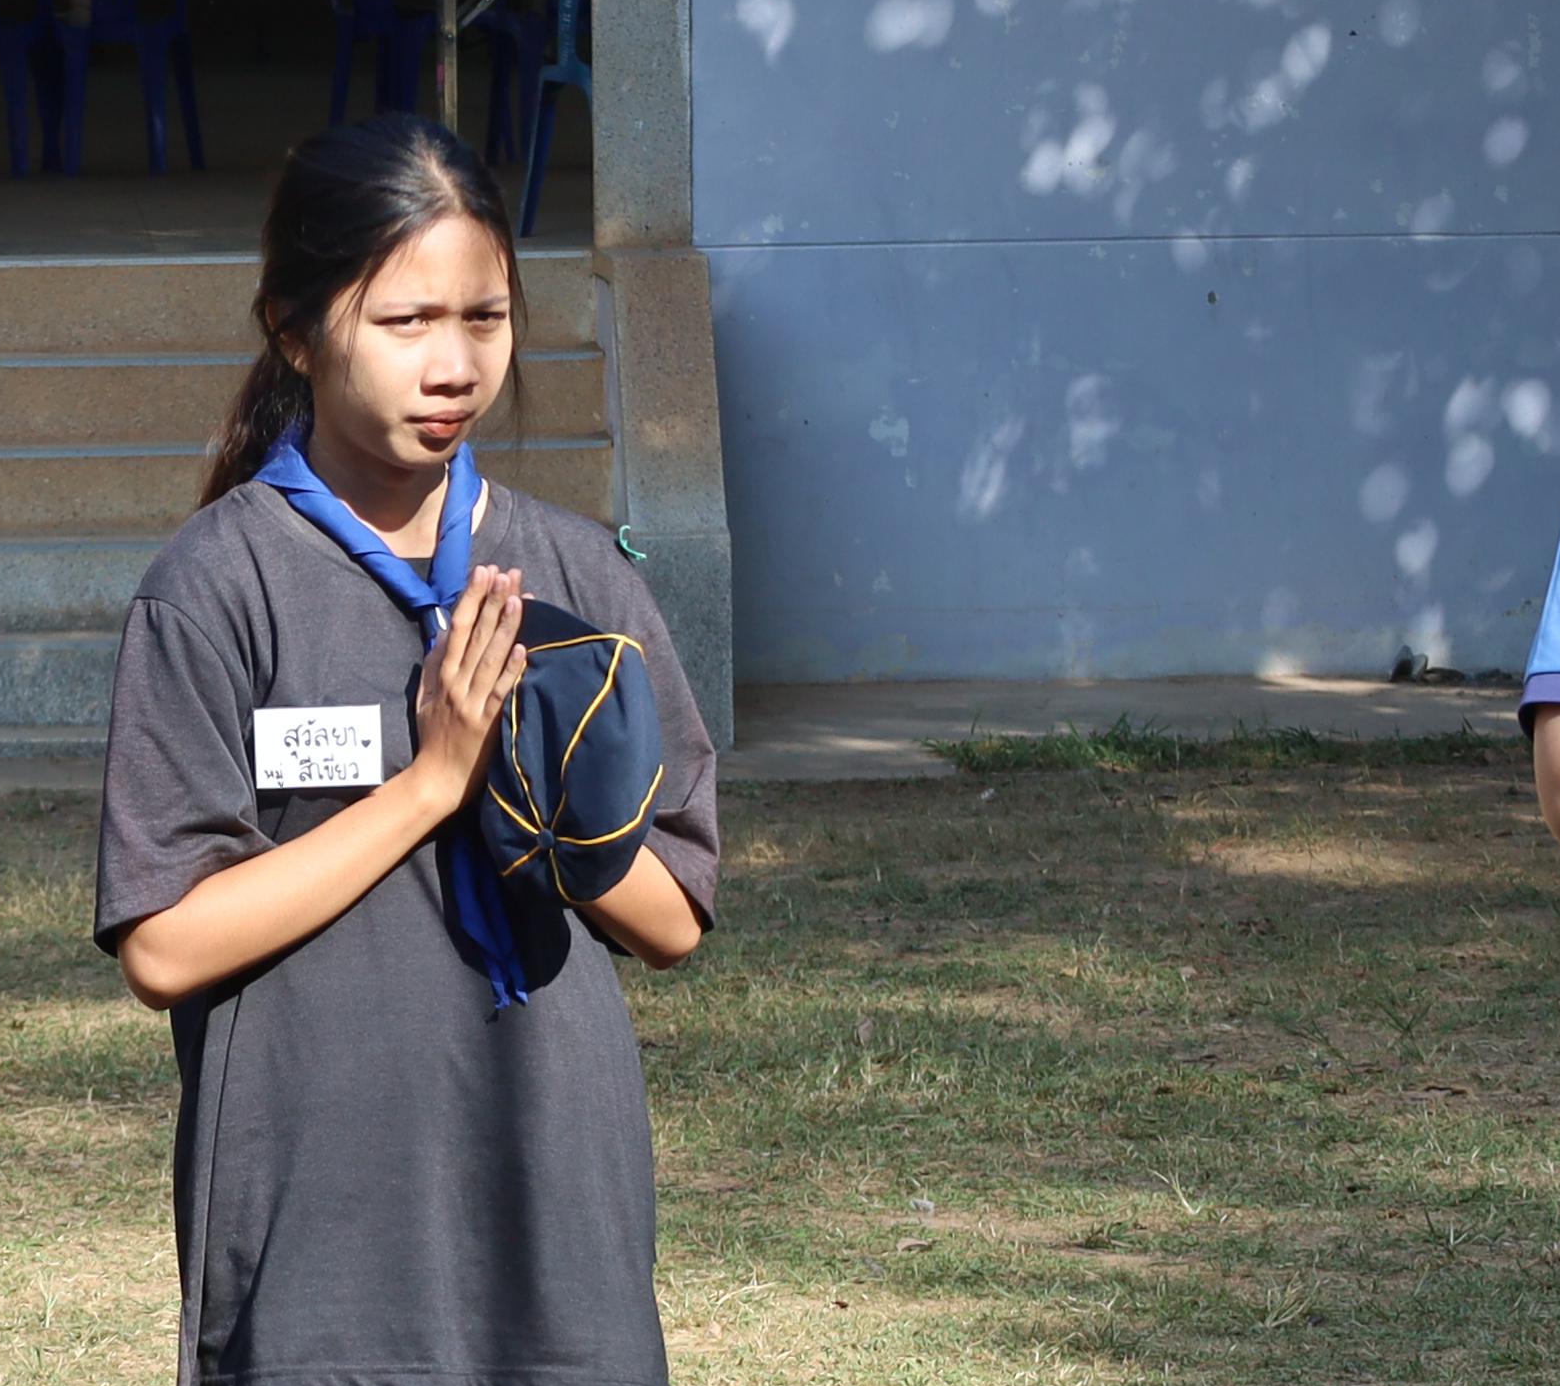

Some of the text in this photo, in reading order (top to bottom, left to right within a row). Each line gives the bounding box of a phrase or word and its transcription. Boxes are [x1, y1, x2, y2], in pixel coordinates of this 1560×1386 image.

[284, 719, 357, 759] สุวัลยา
[264, 753, 360, 788] หมู่ สีเขียว
